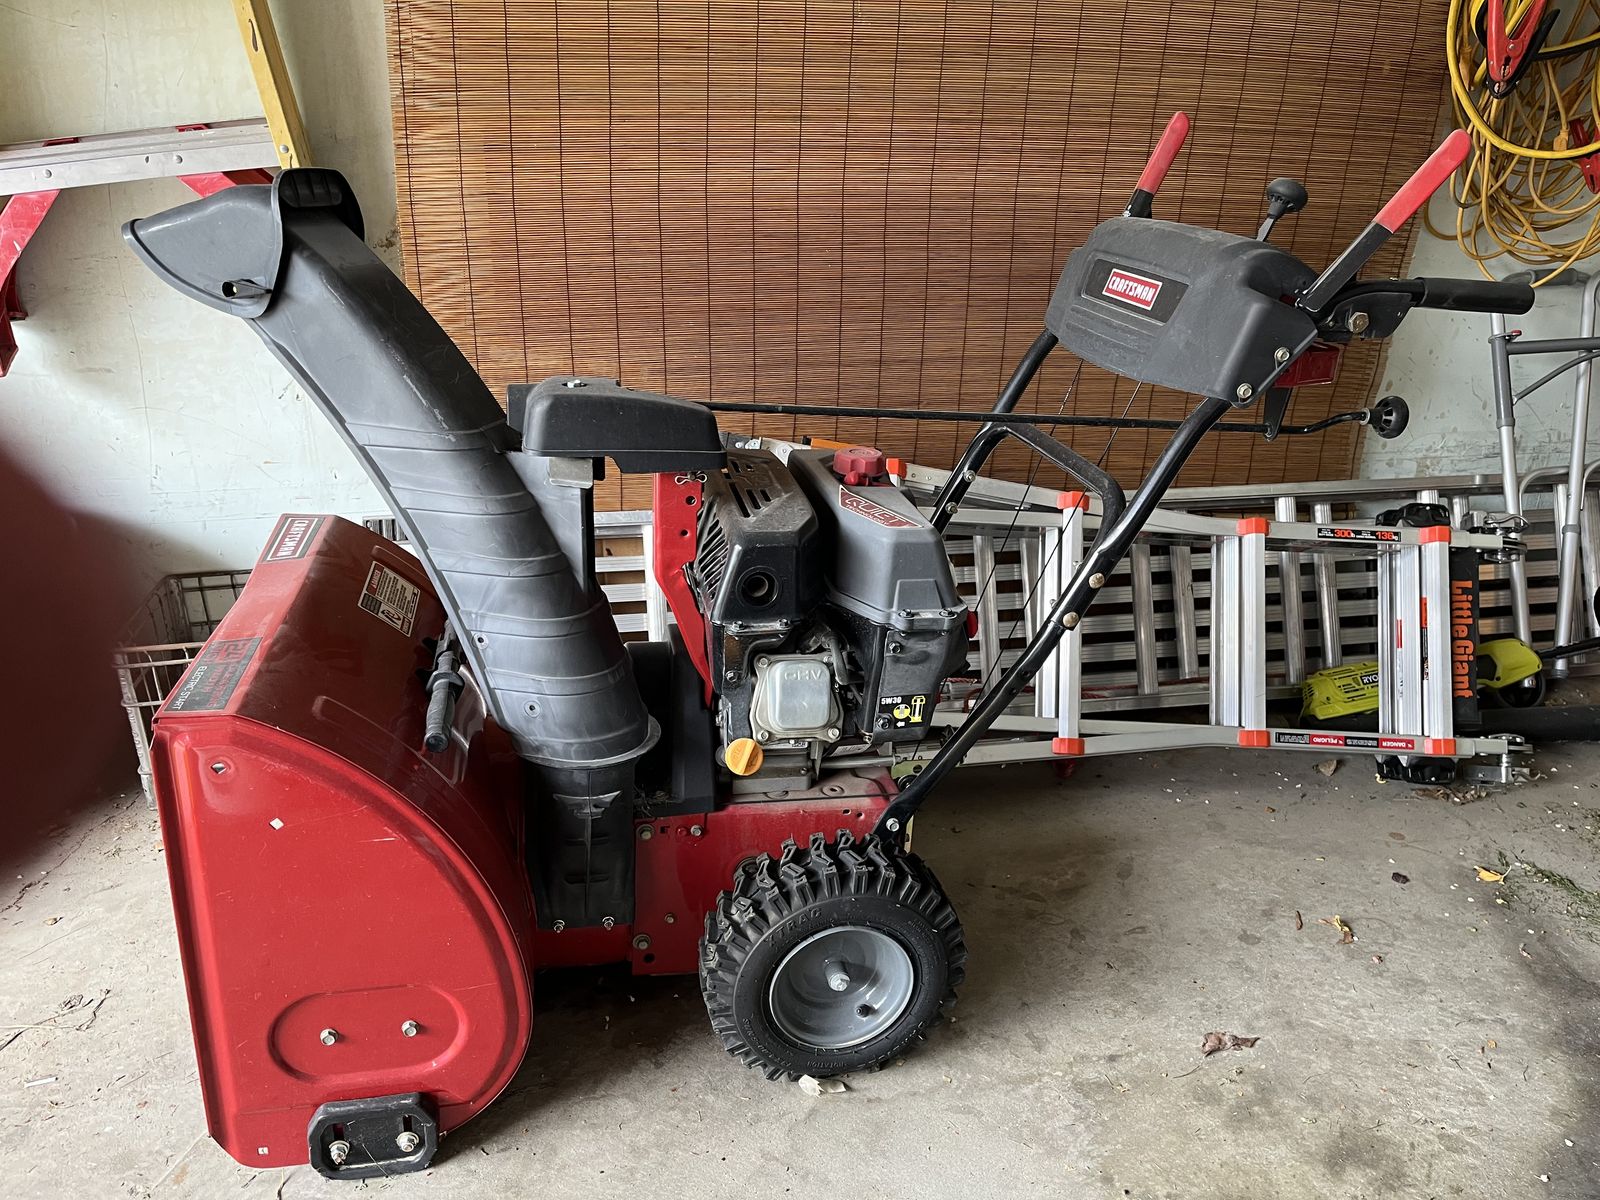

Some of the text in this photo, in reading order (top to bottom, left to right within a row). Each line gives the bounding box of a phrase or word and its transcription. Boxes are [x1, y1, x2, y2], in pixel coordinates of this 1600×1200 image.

[1108, 276, 1156, 302] CRAFTSMAN
[846, 497, 906, 522] QUIET
[846, 505, 889, 525] TECHNOLOGY
[276, 520, 309, 556] CRAFTSMAN
[1451, 580, 1474, 698] Little Giant
[172, 666, 208, 710] ELECTRIC START
[1361, 674, 1379, 685] RYO
[881, 696, 902, 704] 5W30
